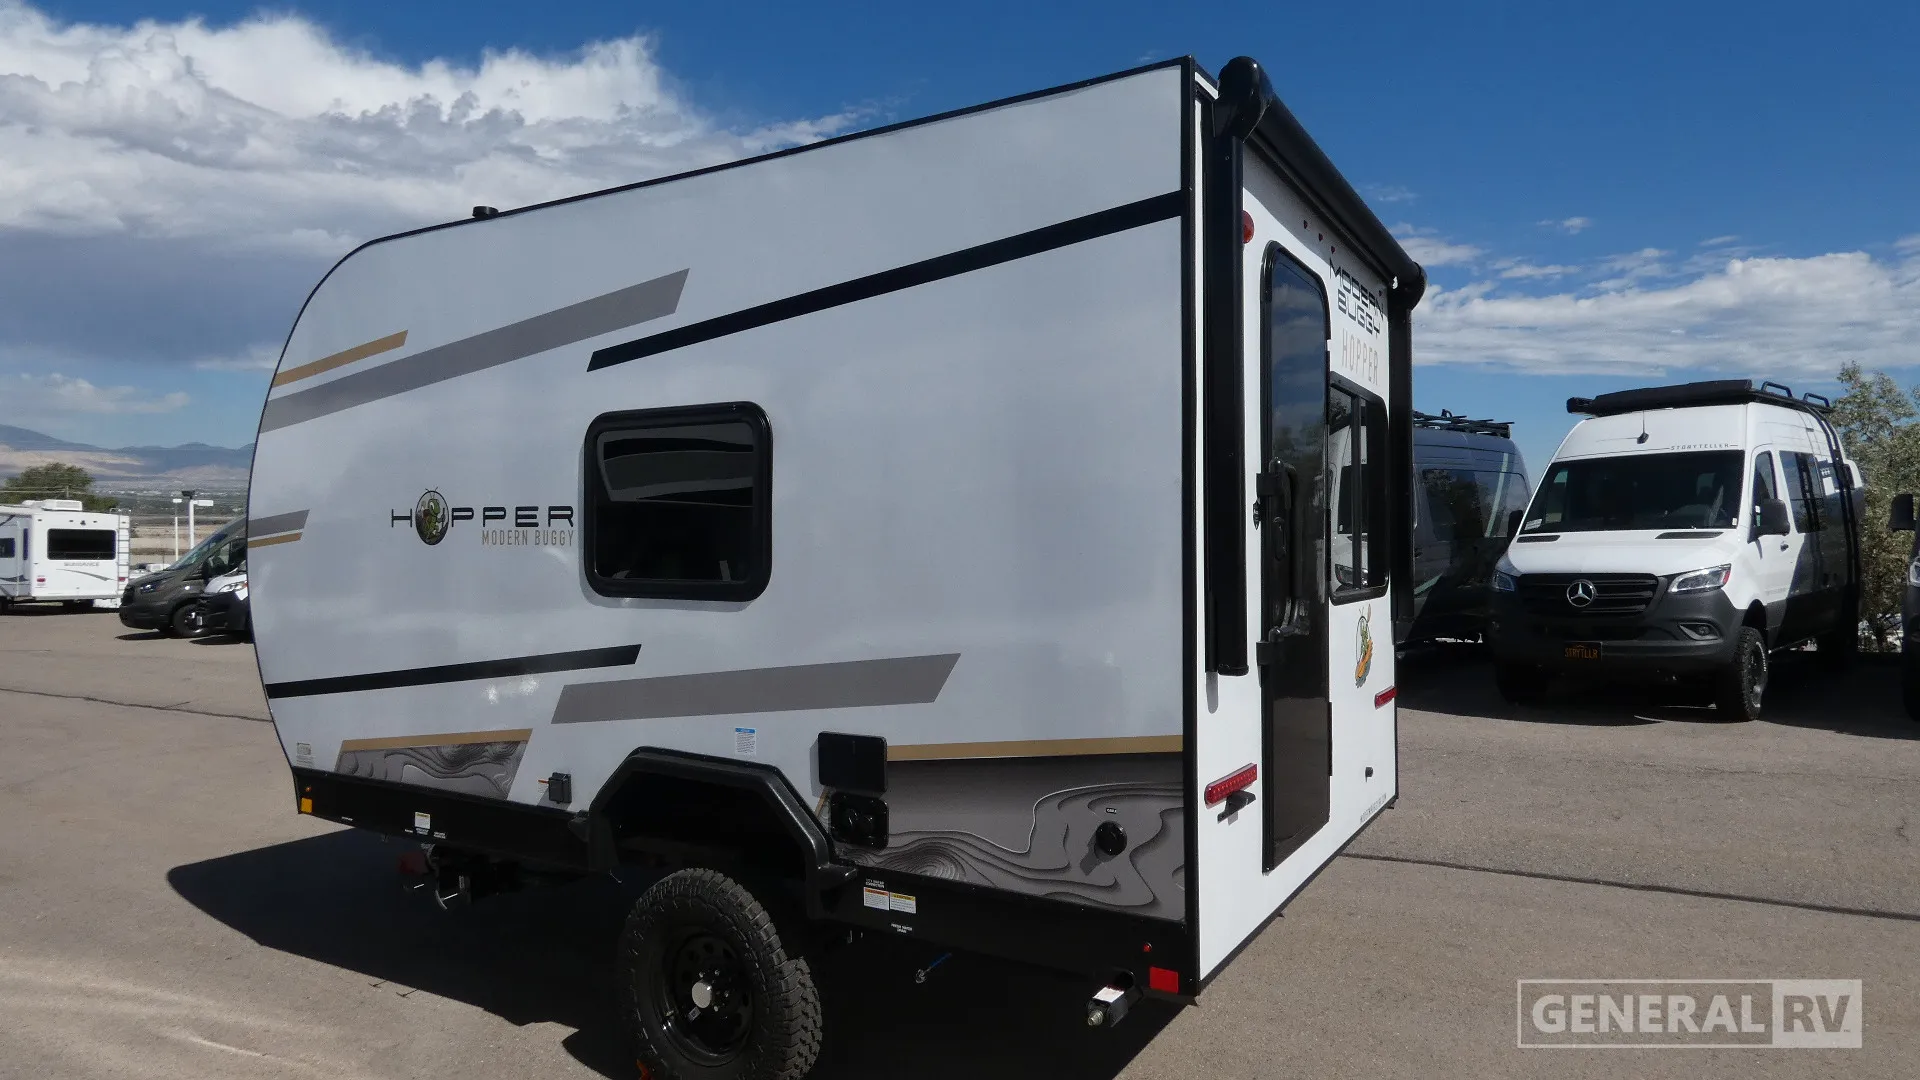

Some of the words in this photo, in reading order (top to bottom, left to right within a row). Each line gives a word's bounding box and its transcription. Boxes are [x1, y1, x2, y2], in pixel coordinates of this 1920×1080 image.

[1329, 257, 1384, 321] MODERN
[1337, 288, 1380, 340] BUGGY
[1341, 327, 1379, 386] HOPPER
[1670, 443, 1729, 451] STORYTELLER
[481, 529, 529, 546] MODERN
[534, 529, 574, 546] BUGGY
